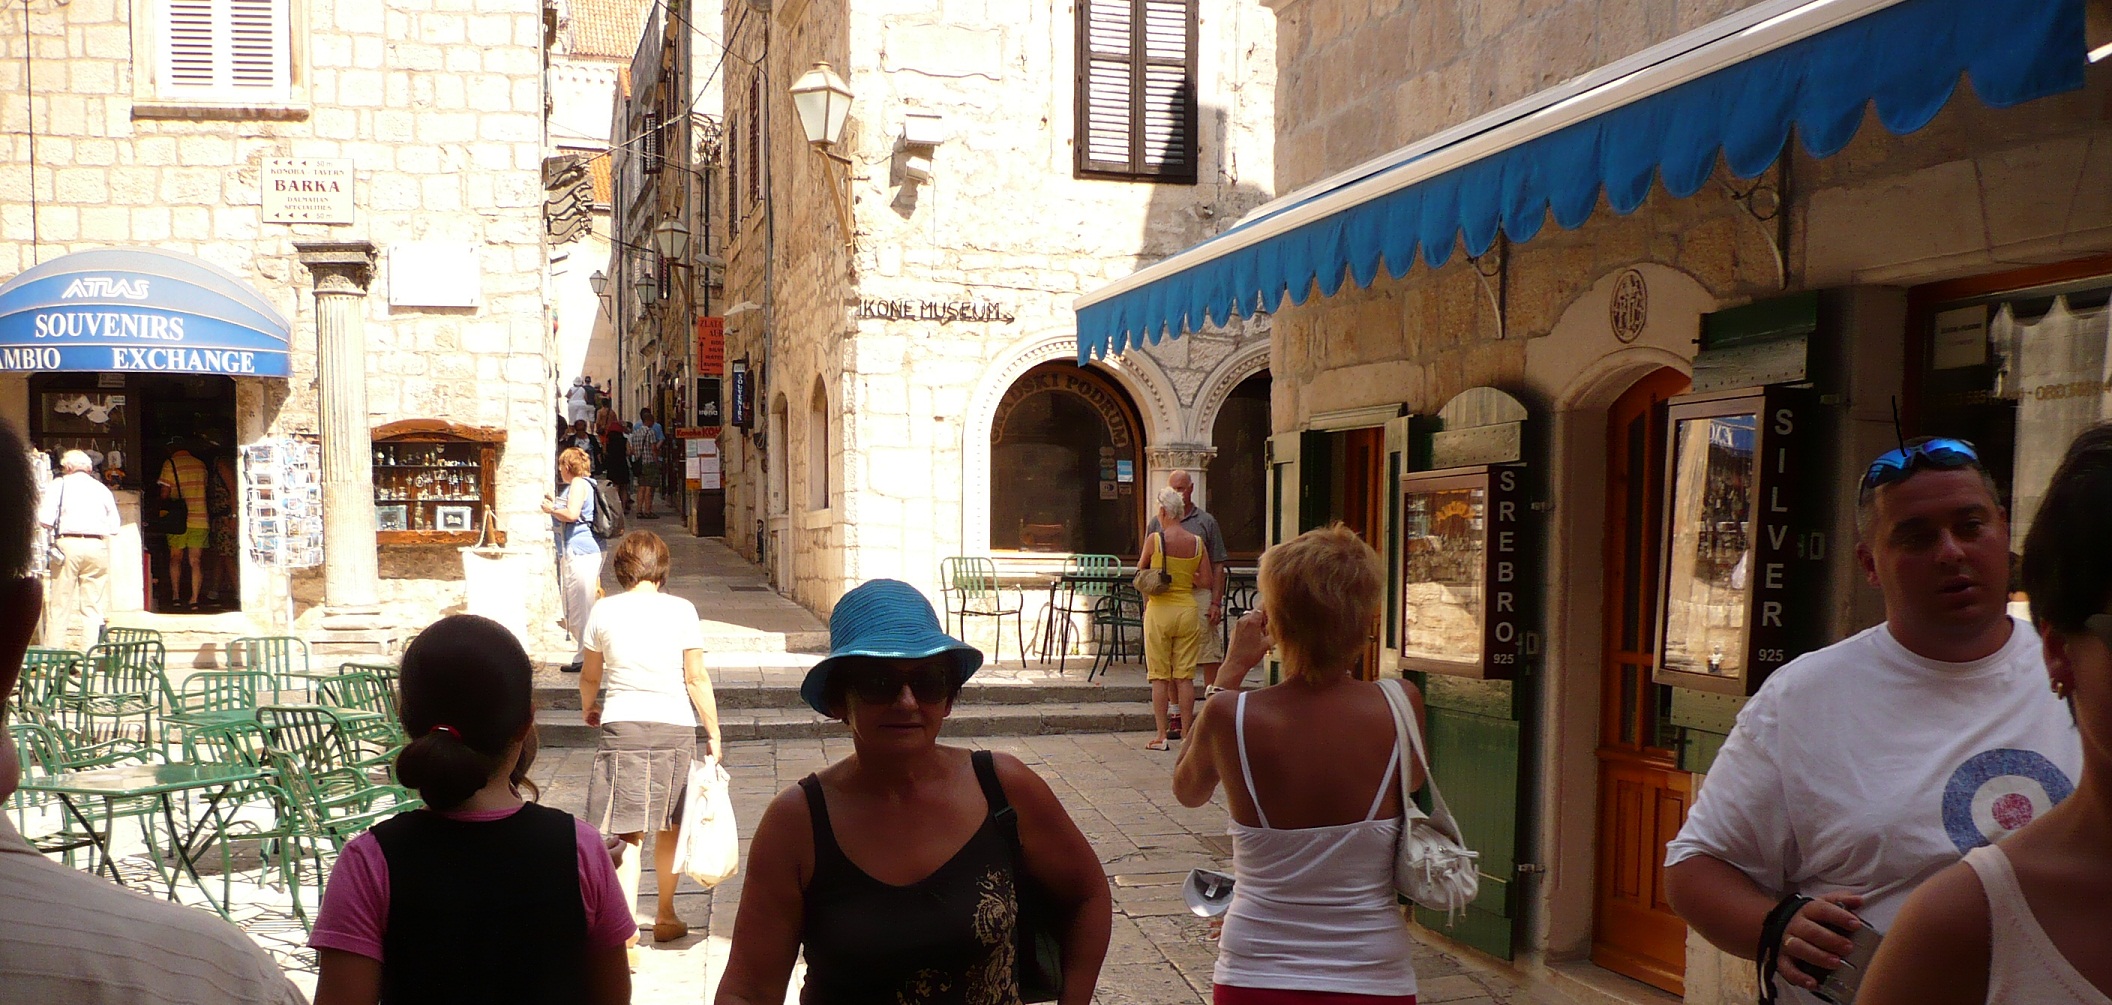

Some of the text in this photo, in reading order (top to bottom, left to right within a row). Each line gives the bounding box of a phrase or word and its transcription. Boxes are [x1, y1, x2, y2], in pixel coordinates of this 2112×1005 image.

[275, 179, 340, 192] BARKA
[61, 277, 150, 300] ATLAS
[857, 299, 1001, 320] IKONE MUSEUM
[35, 313, 185, 341] SOUVENIRS
[112, 347, 255, 373] EXCHANGE
[1065, 375, 1129, 446] PODRUM
[1761, 408, 1794, 628] SILVER
[1494, 470, 1517, 644] SREBRO
[1492, 653, 1515, 665] 925
[1758, 648, 1784, 662] 925
